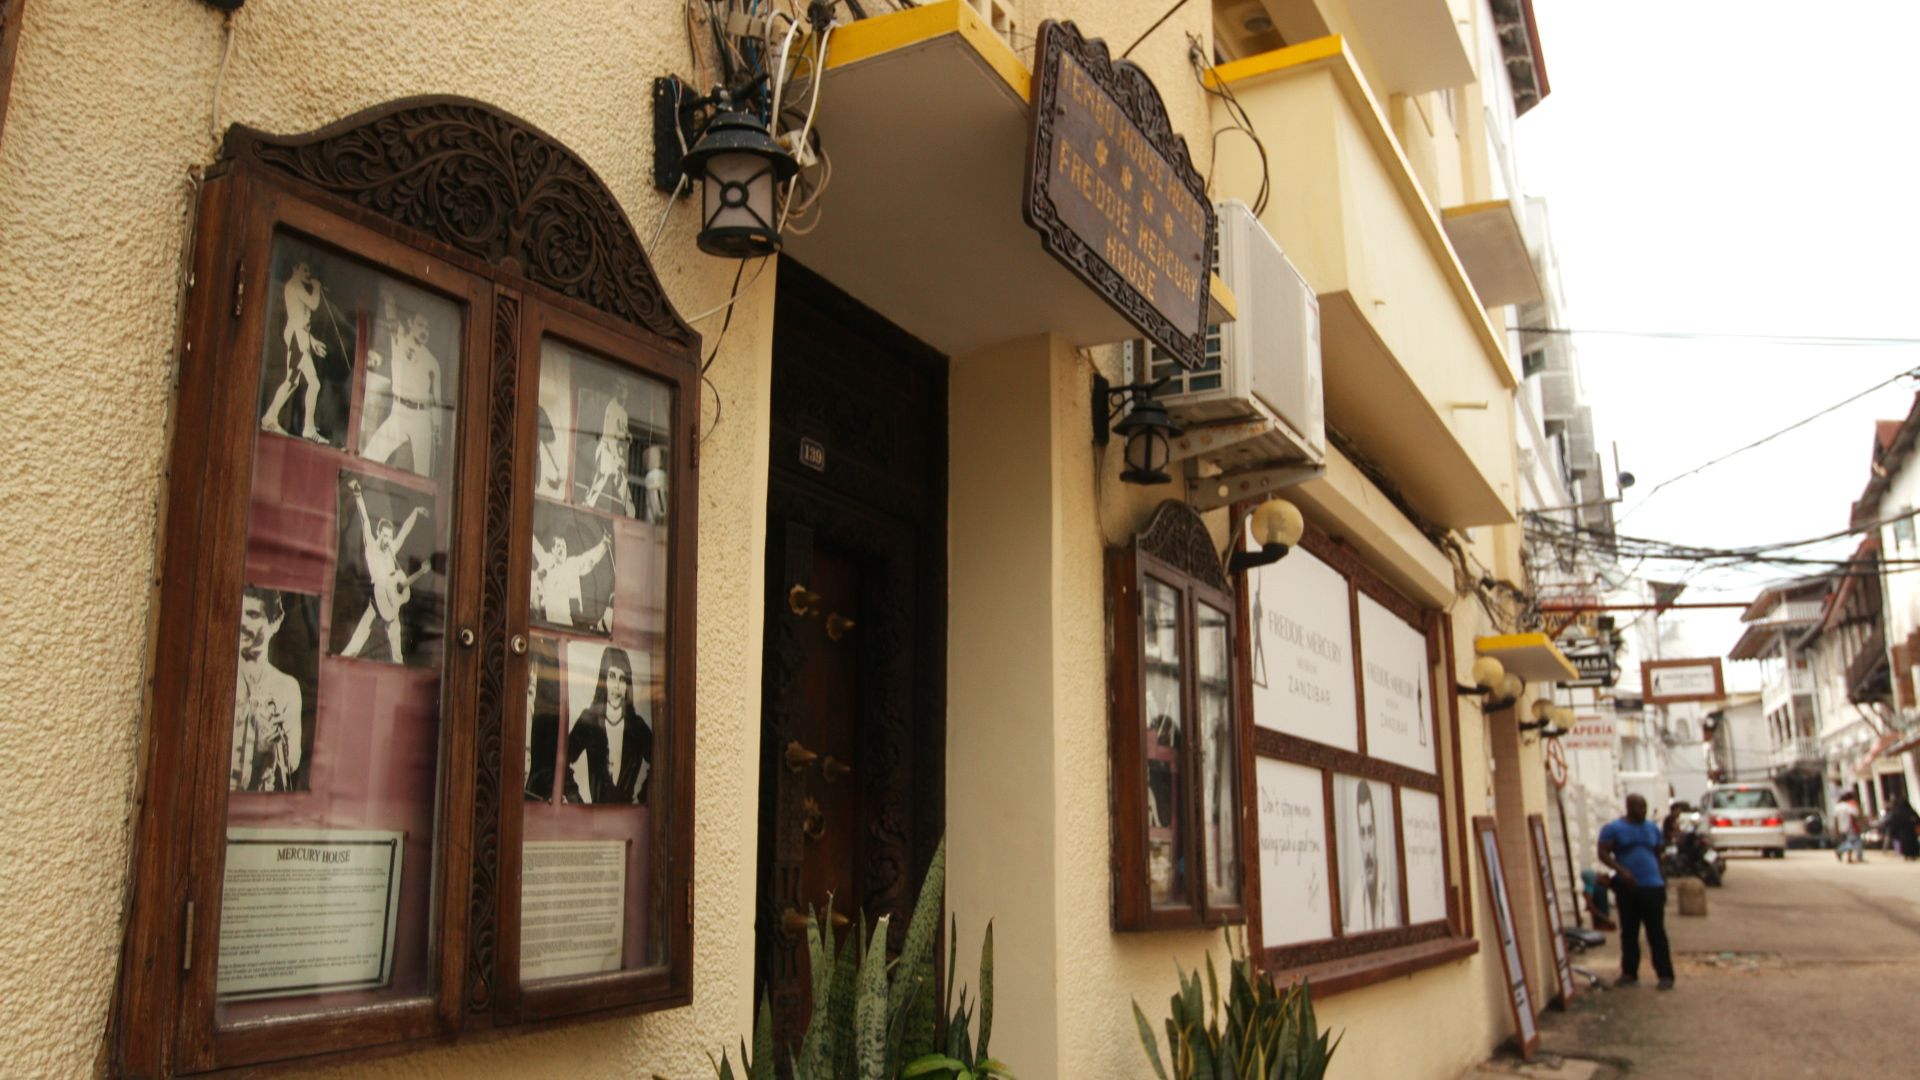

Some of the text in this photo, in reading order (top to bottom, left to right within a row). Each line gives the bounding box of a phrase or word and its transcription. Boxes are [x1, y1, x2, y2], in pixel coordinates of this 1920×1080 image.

[1060, 52, 1205, 240] TEMBO HOUSE HOTEL
[1058, 138, 1199, 303] FREDDIE MERCURY
[1105, 228, 1156, 302] HOUSE
[1268, 609, 1342, 664] FREDDIE MERCURY
[1288, 674, 1332, 706] ZANZIBAR
[277, 847, 351, 864] MERCURY HOUSE
